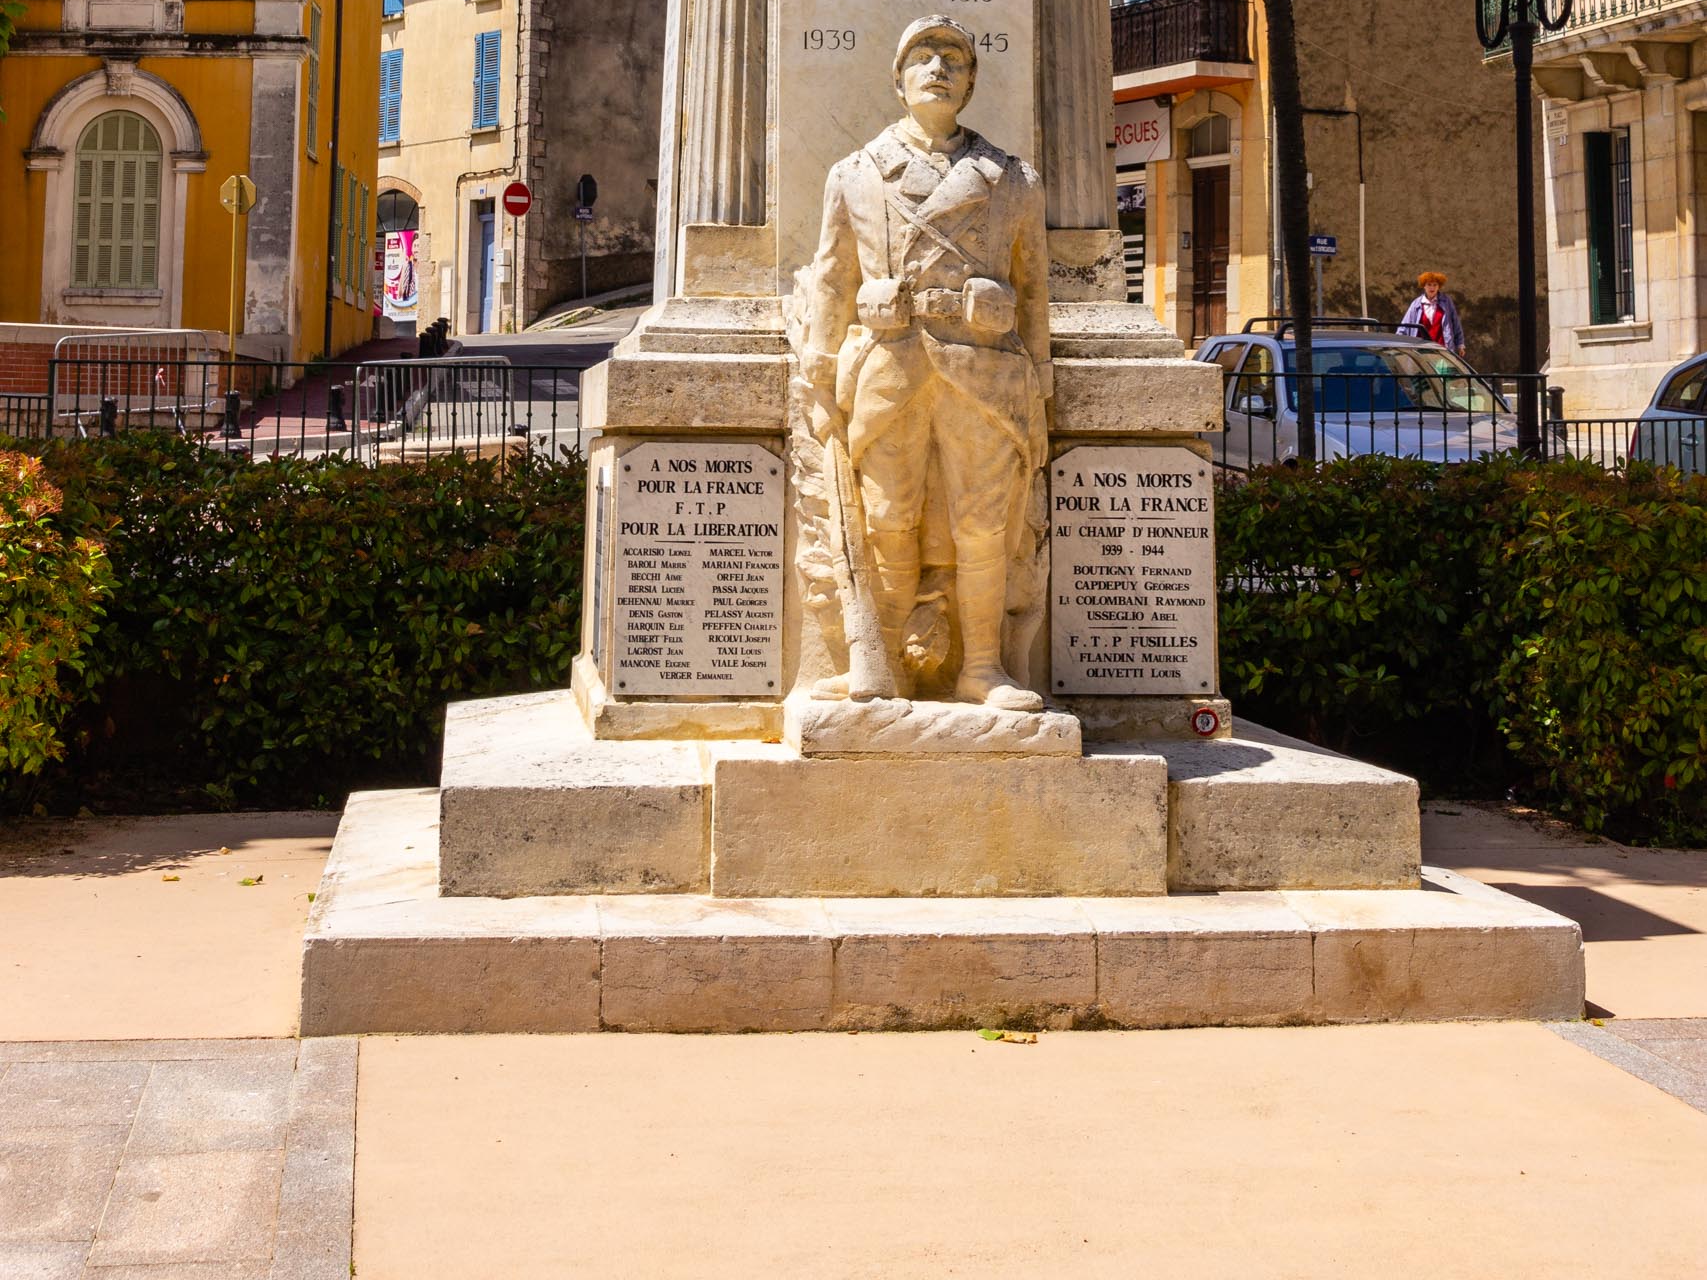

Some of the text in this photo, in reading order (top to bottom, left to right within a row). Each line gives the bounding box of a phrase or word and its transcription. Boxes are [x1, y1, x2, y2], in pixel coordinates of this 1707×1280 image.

[804, 30, 855, 50] 1939
[968, 32, 1008, 52] 45
[651, 459, 752, 473] A NOS MORTS
[1073, 473, 1192, 488] A NOS MORTS
[637, 480, 764, 494] POUR LA FRANCE
[1056, 496, 1208, 512] POUR LA FRANCE
[621, 522, 778, 536] POUR LA LIBERATION
[1056, 526, 1071, 536] AU
[1079, 526, 1125, 537] CHAMP
[1102, 545, 1122, 555] 1939
[1142, 545, 1164, 556] 1944
[702, 561, 742, 569] MARIANI
[1074, 566, 1191, 576] BOUTIGNY FERNAND
[717, 573, 744, 581] ORFEI
[629, 585, 657, 593] BERSIA
[740, 586, 768, 594] JACQUES
[1075, 581, 1189, 591] CAPDEPUY GEORGES
[1076, 596, 1148, 605] COLOMBANI
[1156, 597, 1205, 606] RAYMOND
[705, 610, 743, 618] PELASSY
[1088, 611, 1178, 621] USSEGLIO ABEL
[628, 622, 665, 631] HARQUIN
[1130, 637, 1197, 647] FUSILLES
[717, 647, 738, 655] TAXI
[1079, 653, 1187, 662] FLANDIN MAURICE
[1087, 668, 1181, 678] OLIVETTI LOUIS
